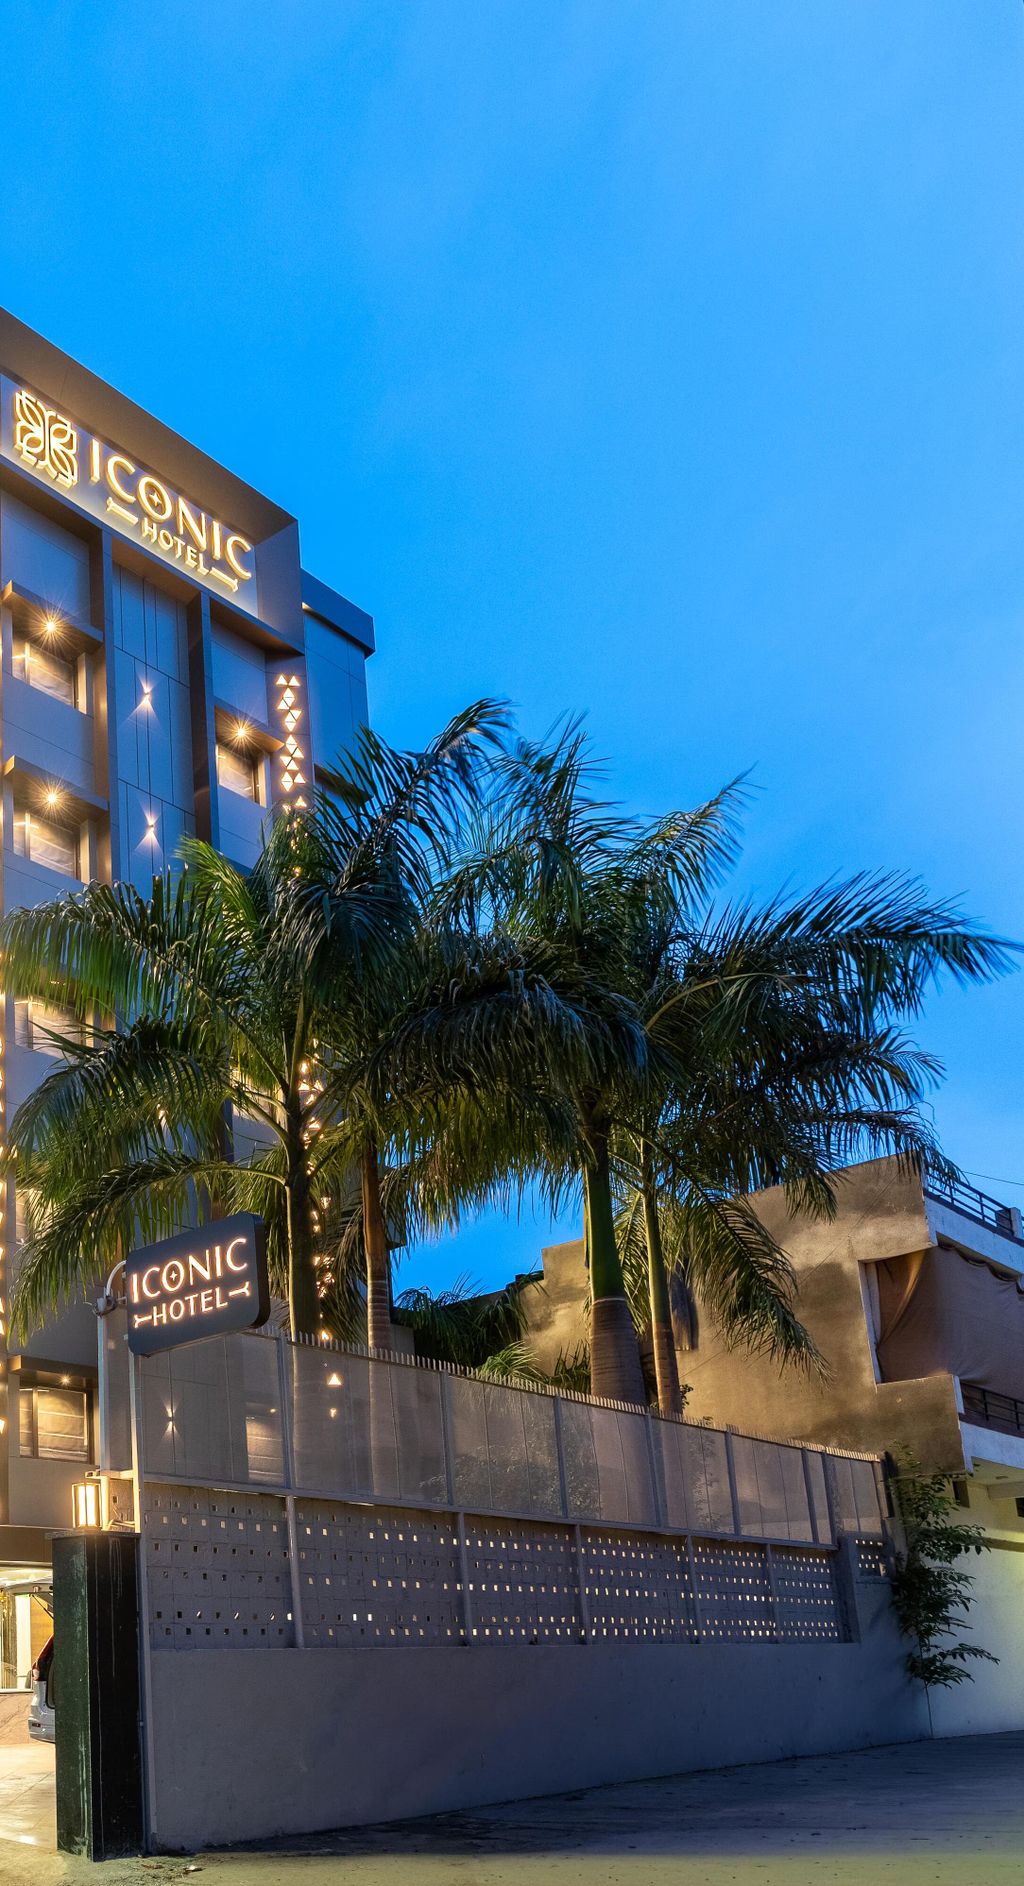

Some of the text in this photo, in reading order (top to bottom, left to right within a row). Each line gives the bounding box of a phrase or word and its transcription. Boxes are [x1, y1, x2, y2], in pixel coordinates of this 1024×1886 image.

[90, 439, 252, 580] ICONIC
[142, 517, 209, 576] HOTEL
[131, 1238, 248, 1303] ICONIC
[152, 1287, 228, 1327] HOTEL
